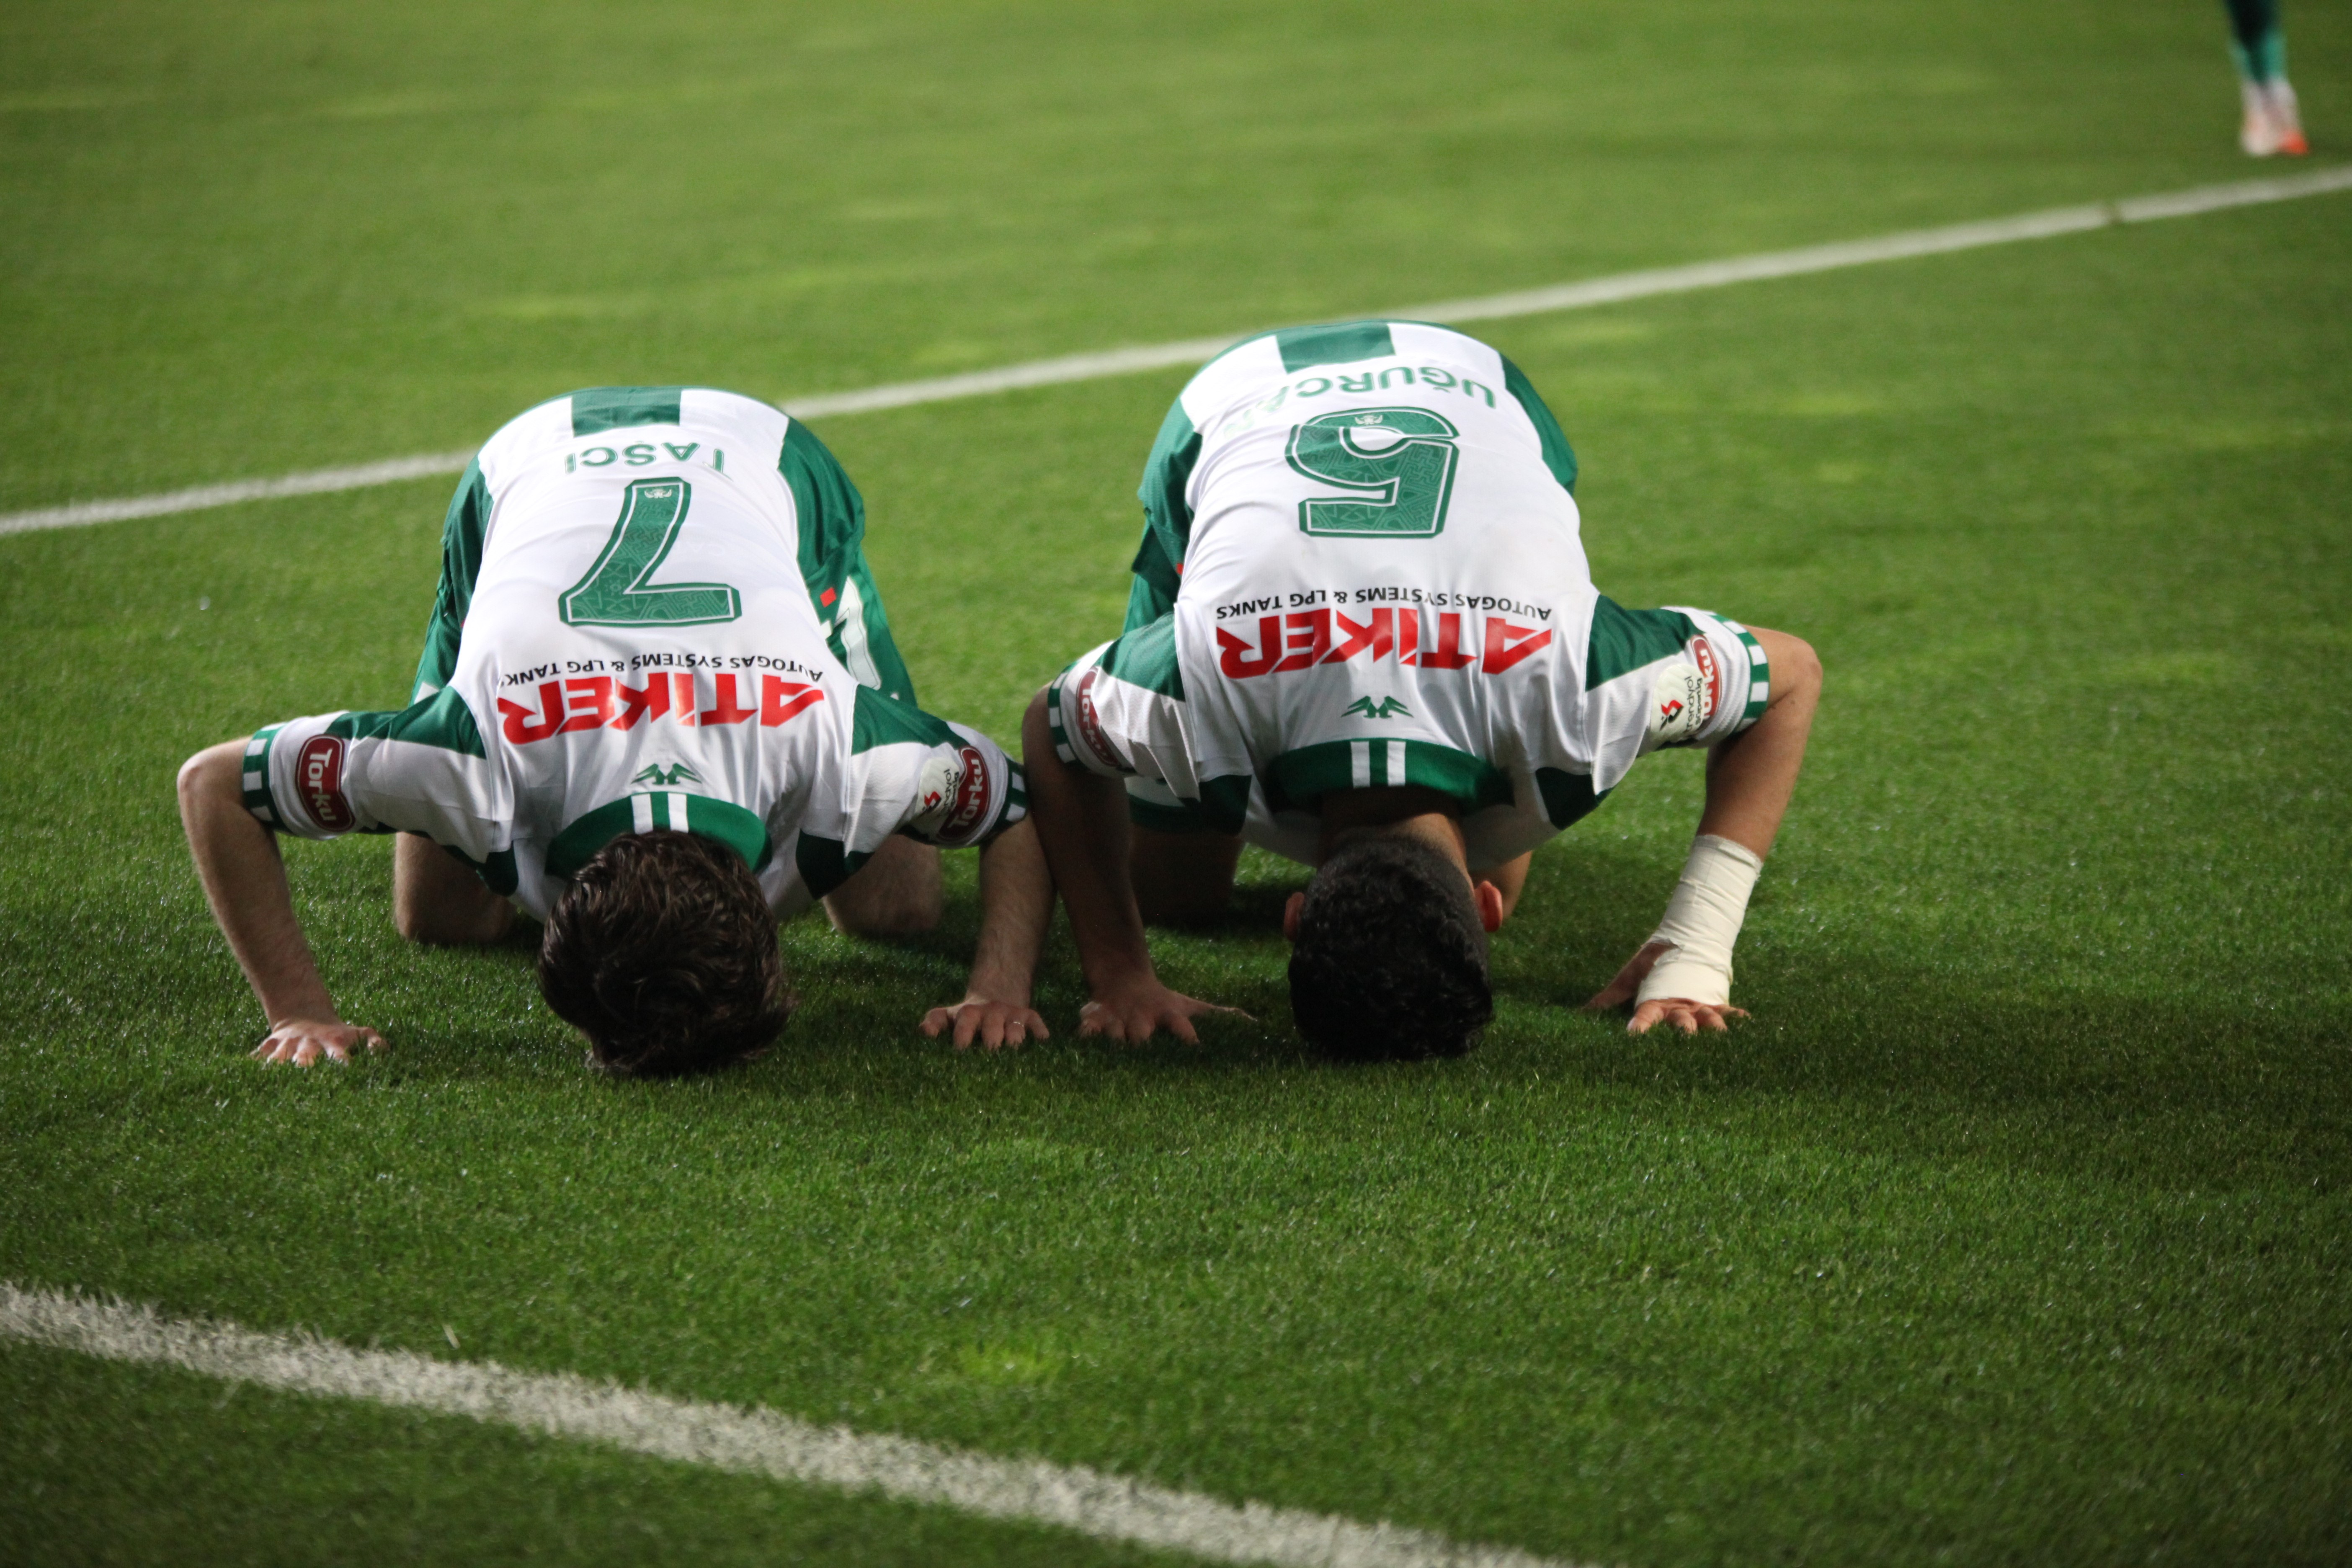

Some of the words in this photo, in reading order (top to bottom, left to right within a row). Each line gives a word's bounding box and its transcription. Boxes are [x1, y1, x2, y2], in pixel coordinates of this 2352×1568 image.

[1285, 406, 1459, 539] 5
[559, 477, 742, 628] 7
[1217, 596, 1282, 619] TANKS
[1290, 590, 1326, 607] LPG
[1333, 591, 1348, 603] &
[1356, 587, 1448, 606] SYSTEMS
[1455, 594, 1552, 621] AUTOGAS
[567, 660, 604, 673] LPG
[611, 660, 625, 672] &
[632, 653, 722, 671] SYSTEMS
[730, 656, 823, 682] AUTOGAS
[500, 663, 561, 687] TANK
[309, 749, 336, 821] Torku
[948, 759, 983, 828] Torku
